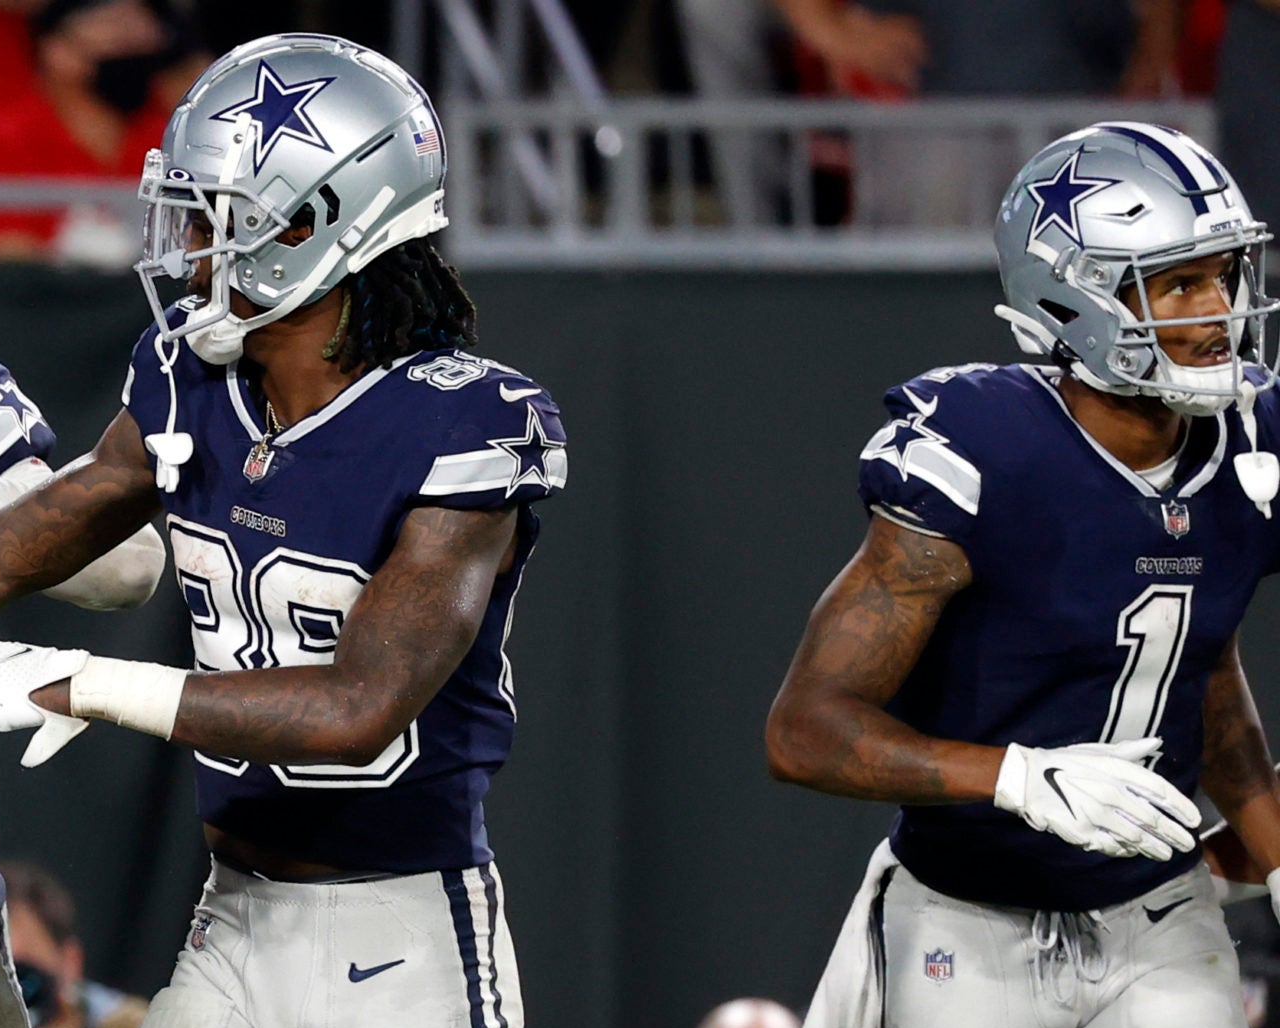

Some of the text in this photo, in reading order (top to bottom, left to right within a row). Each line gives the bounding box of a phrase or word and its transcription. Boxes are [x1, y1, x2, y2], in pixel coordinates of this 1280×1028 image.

[230, 504, 287, 538] COWBOYS
[1135, 556, 1203, 575] COWBOYS
[1098, 583, 1195, 772] 1
[929, 964, 951, 978] NFL
